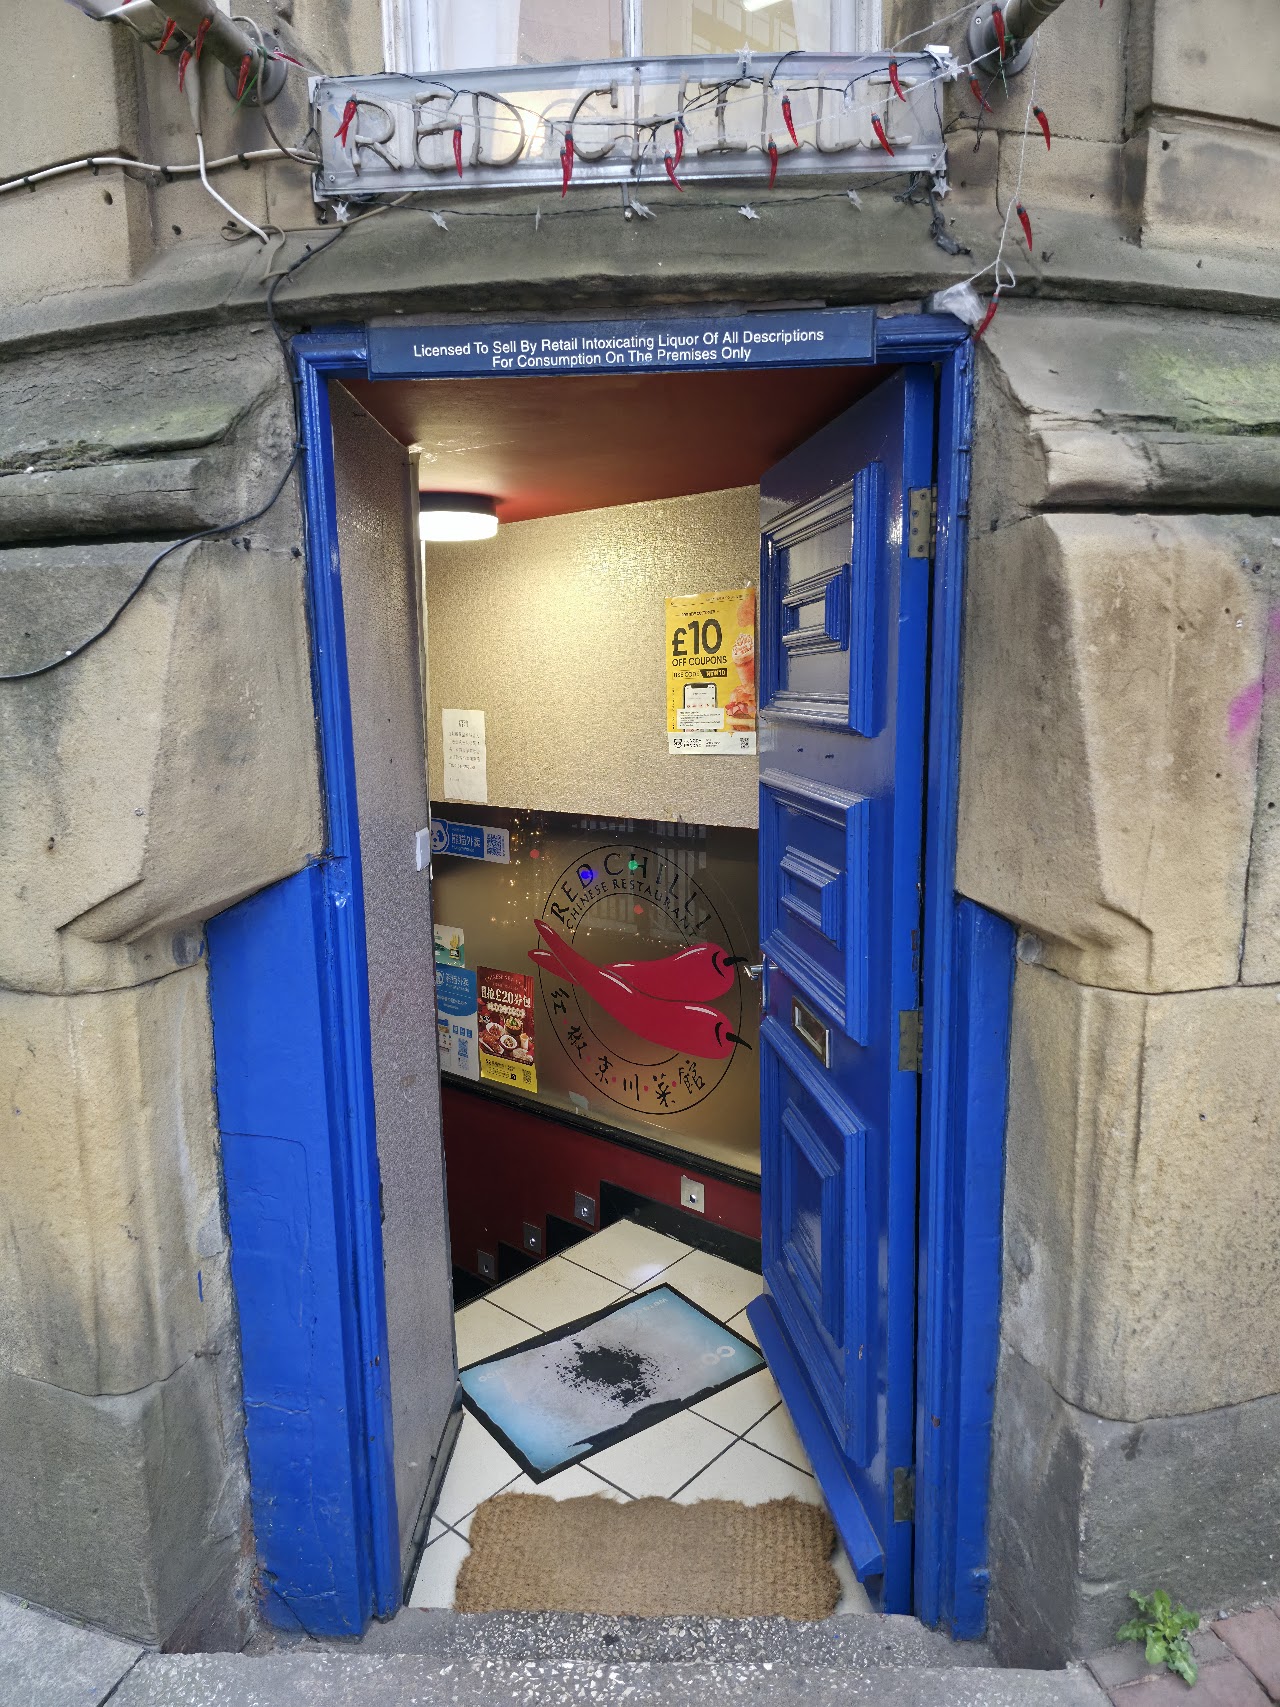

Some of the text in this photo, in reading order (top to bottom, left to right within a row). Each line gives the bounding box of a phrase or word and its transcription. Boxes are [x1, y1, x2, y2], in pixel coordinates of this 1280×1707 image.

[350, 69, 917, 172] RED CHILLI
[414, 329, 824, 357] Licensed To Sell By Retail Intoxicating Liquor Of All Descriptions
[493, 346, 751, 368] For Consumption On The Premises Only
[672, 618, 722, 656] £10
[672, 656, 727, 666] OFF COUPONS
[551, 852, 712, 931] RED CHILLI
[566, 878, 698, 937] CHINESE RESTAURANT
